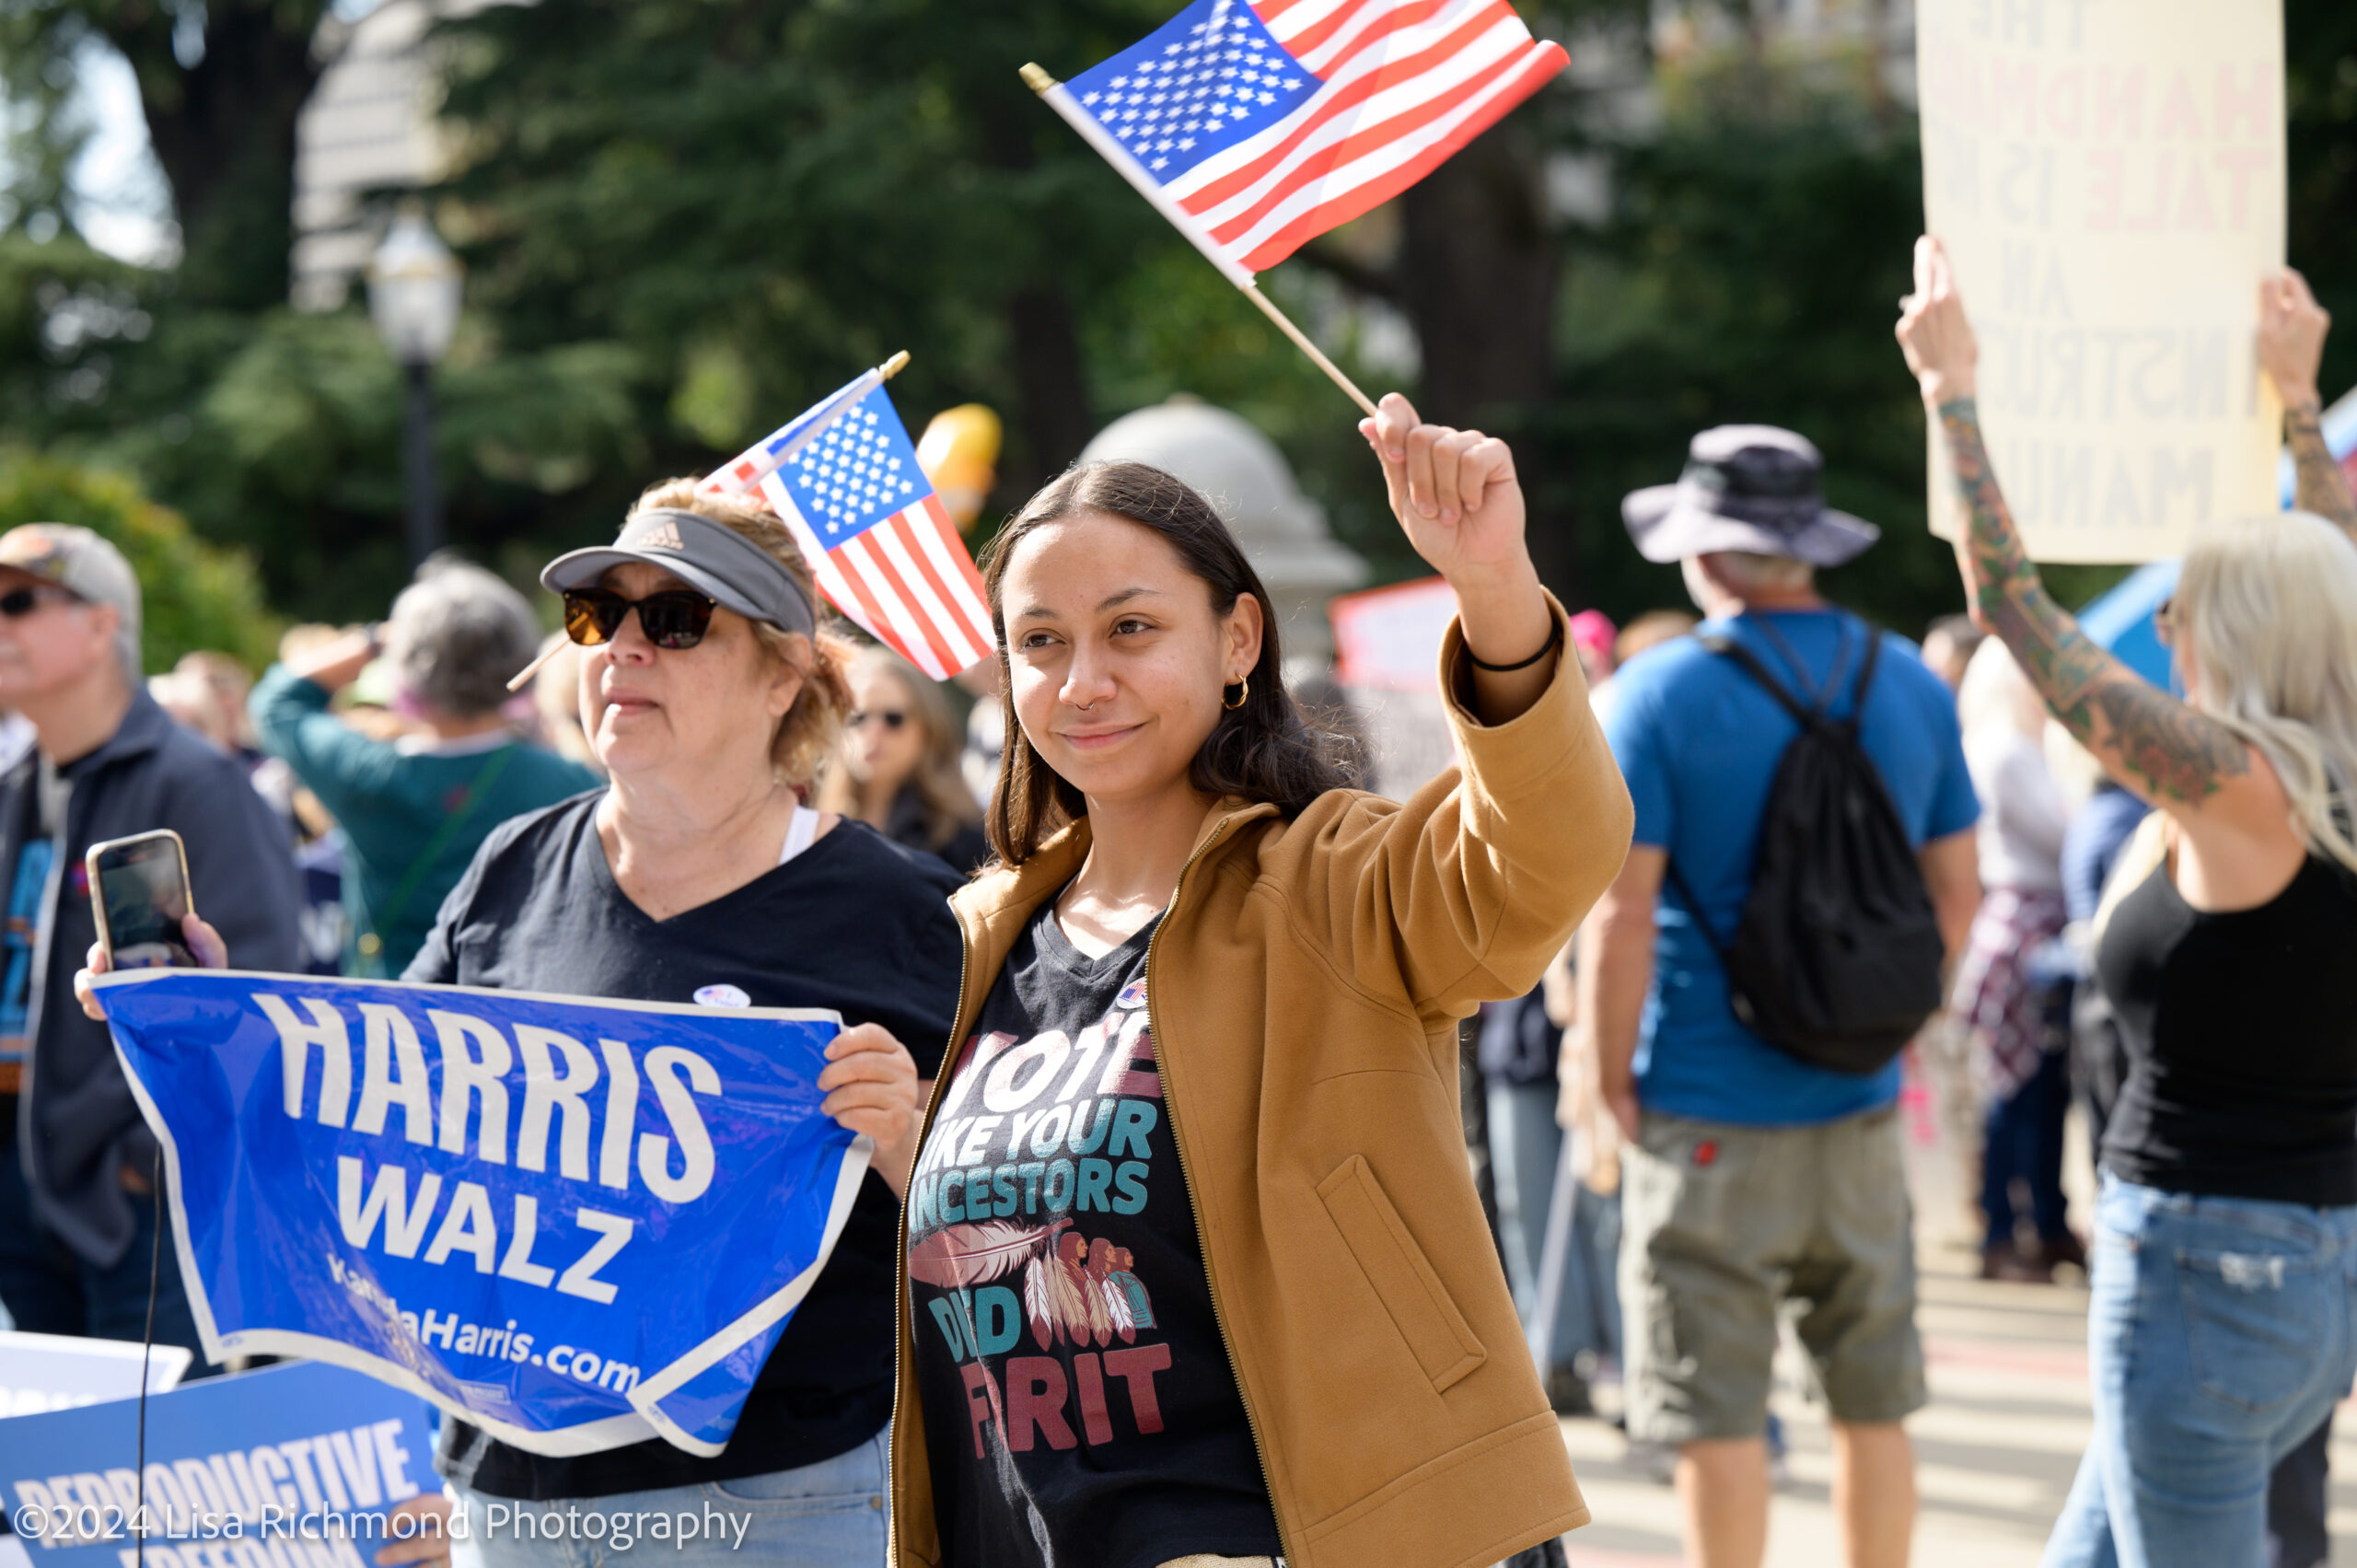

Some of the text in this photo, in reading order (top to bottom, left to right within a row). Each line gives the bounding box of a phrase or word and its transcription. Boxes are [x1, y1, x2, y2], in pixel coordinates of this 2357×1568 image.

[250, 993, 723, 1204] HARRIS
[941, 1011, 1164, 1122] VOTE
[1005, 1098, 1158, 1160] YOUR
[337, 1156, 634, 1306] WALZ
[326, 1252, 642, 1394] KamaHarris.com
[13, 1418, 420, 1551] REPRODUCTIVE
